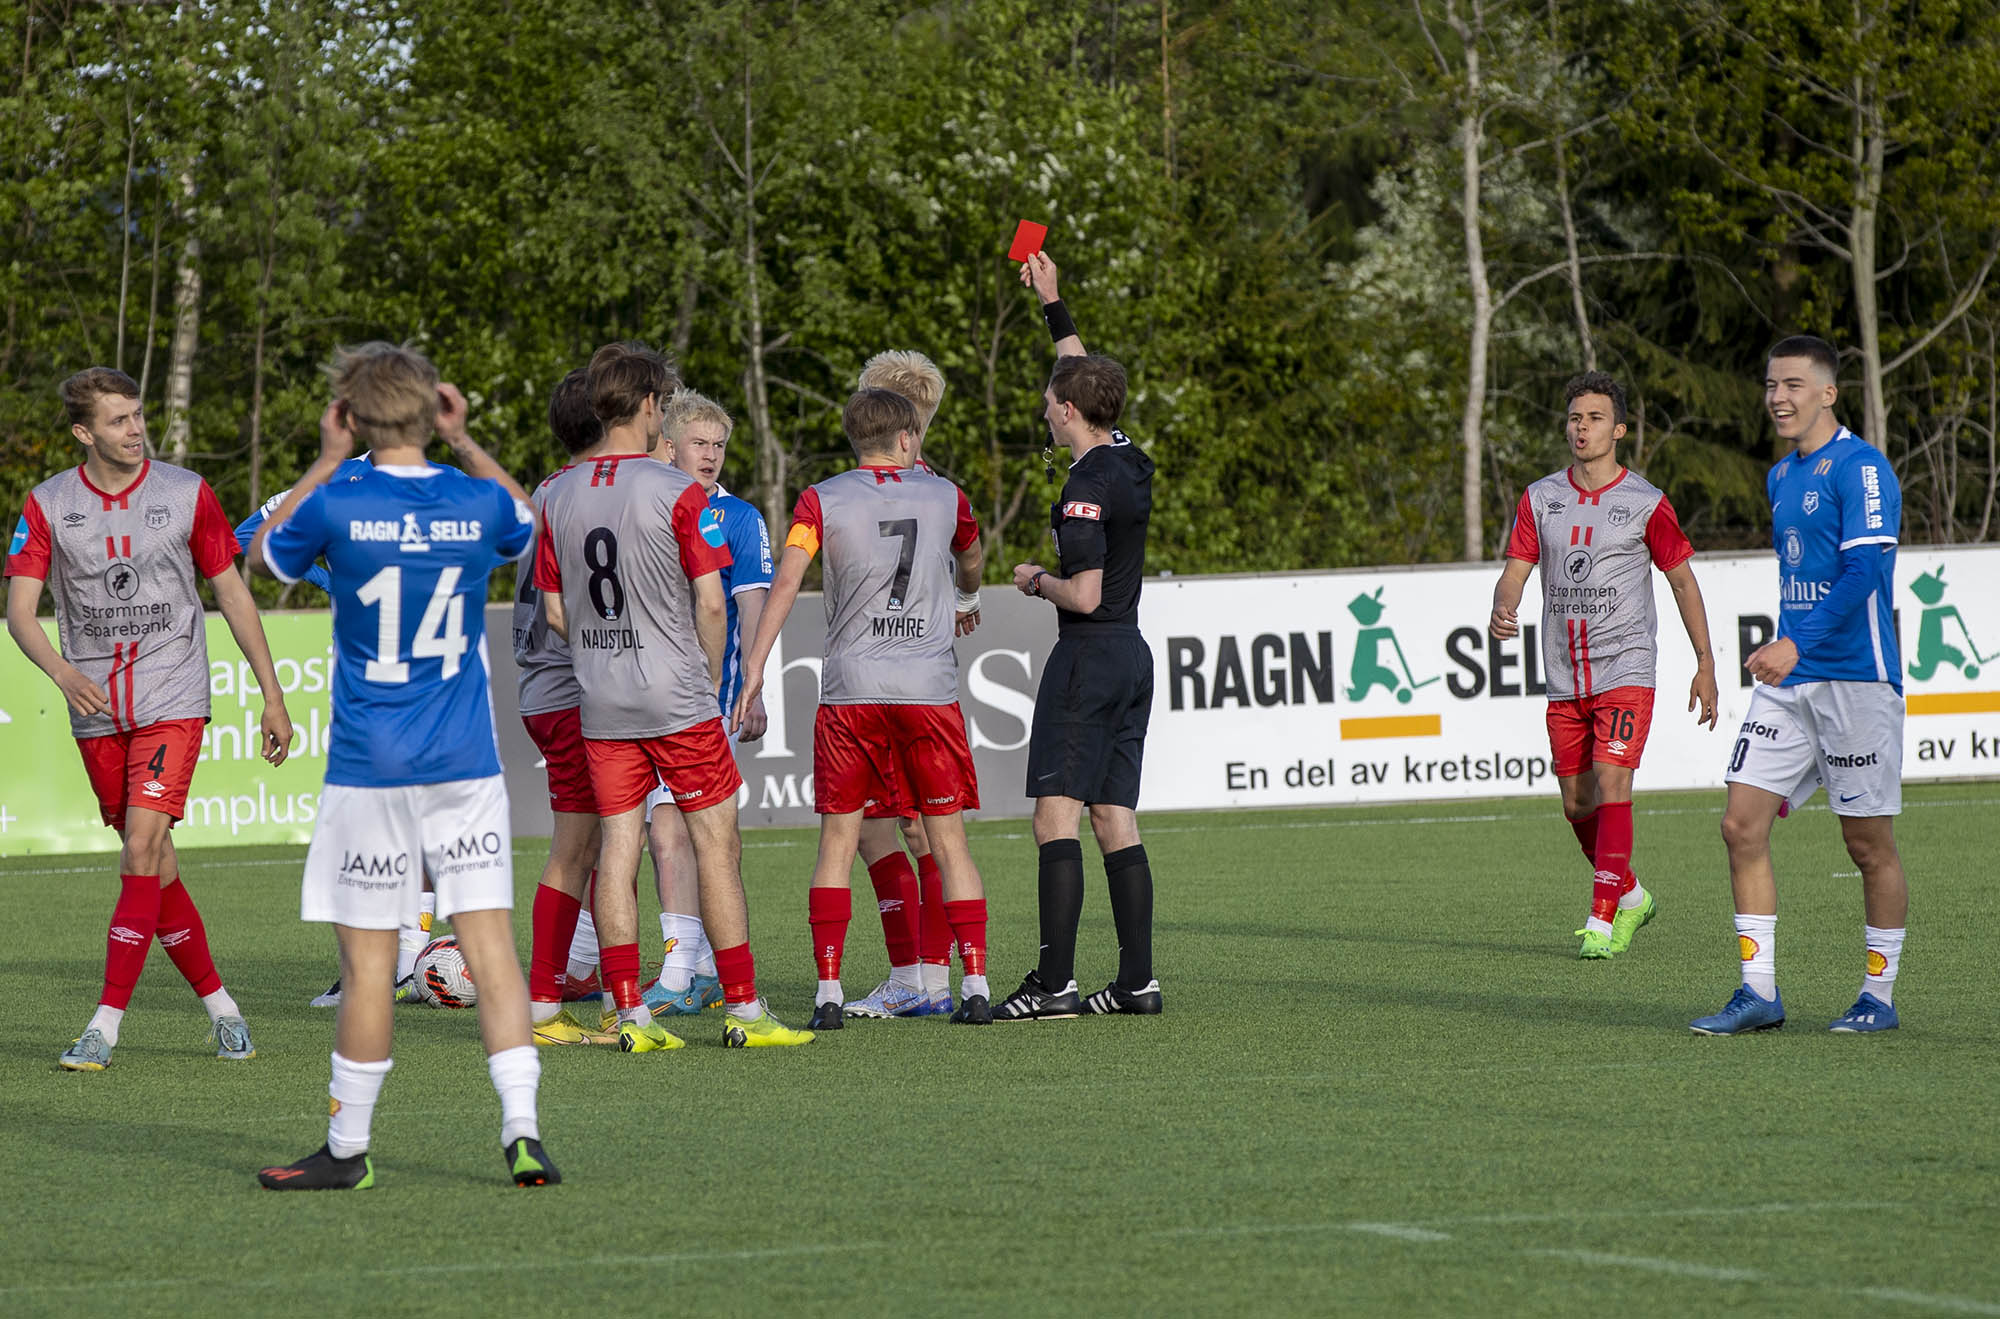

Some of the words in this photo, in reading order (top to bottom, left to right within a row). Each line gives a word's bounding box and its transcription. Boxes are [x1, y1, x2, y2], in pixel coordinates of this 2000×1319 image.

[1064, 503, 1098, 517] VG
[350, 520, 400, 542] RAGN
[429, 520, 482, 542] SELLS
[584, 527, 624, 621] 8
[879, 519, 917, 610] 7
[1780, 575, 1832, 601] ohus
[82, 601, 172, 620] Strømmen
[356, 565, 469, 683] 14
[84, 617, 173, 641] Sparebank
[872, 617, 925, 638] MYHRE
[1167, 630, 1335, 711] RAGN
[199, 708, 331, 762] nhol
[1608, 708, 1635, 741] 16
[147, 743, 167, 779] 4
[1727, 737, 1751, 773] 0
[1822, 749, 1878, 768] omfort
[1918, 739, 1955, 761] av
[1226, 762, 1268, 791] En
[1285, 758, 1335, 787] del
[1351, 761, 1389, 785] av
[1405, 752, 1559, 783] kretsløp
[174, 782, 322, 836] mplus
[675, 789, 703, 801] umbro
[927, 795, 955, 804] umbro
